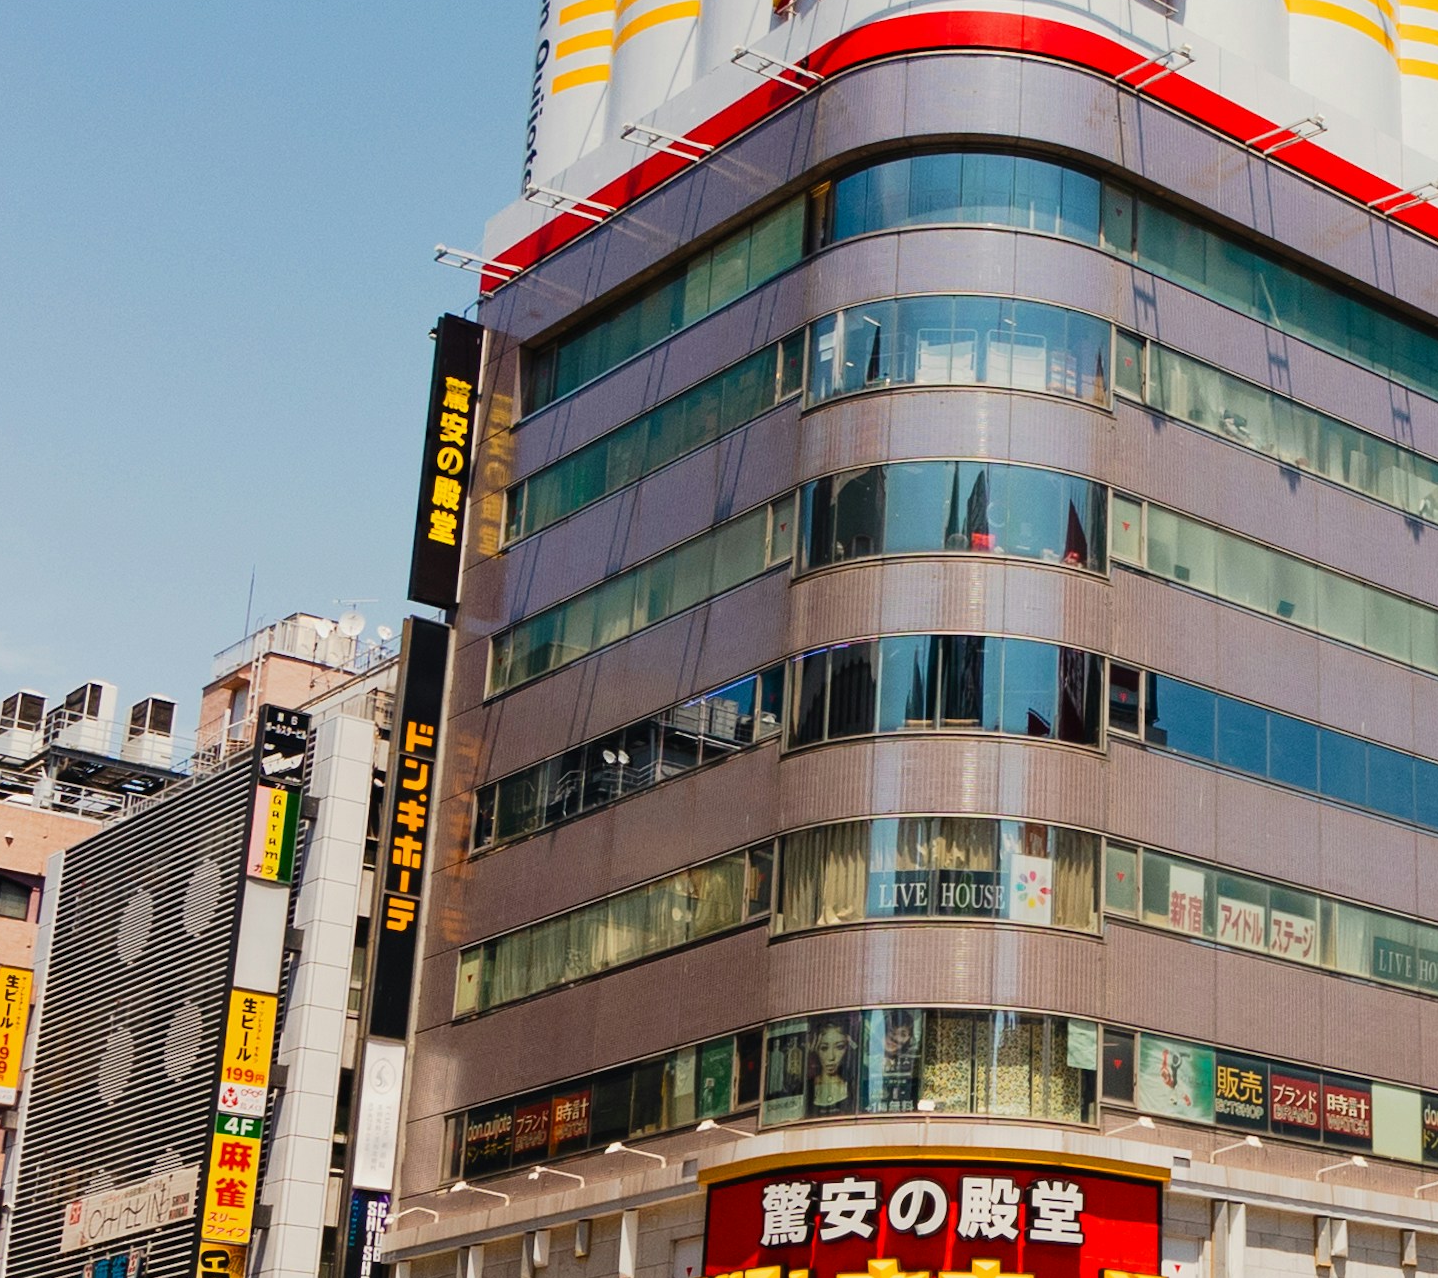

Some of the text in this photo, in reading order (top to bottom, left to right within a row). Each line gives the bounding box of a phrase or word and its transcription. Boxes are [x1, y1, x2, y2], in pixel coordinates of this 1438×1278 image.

[523, 19, 553, 196] Quijote
[428, 376, 474, 547] 驚安の殿堂
[263, 793, 283, 862] Garam
[877, 880, 1006, 910] LIVE HOUSE
[1169, 888, 1317, 959] 新宿 アイドル ステージ
[1378, 947, 1414, 979] LIVE
[0, 973, 21, 1030] 生ビール
[235, 997, 259, 1063] 生ビール
[225, 1065, 265, 1086] 199円
[1216, 1065, 1263, 1106] 販売
[554, 1098, 591, 1124] 時計
[1272, 1082, 1319, 1108] ブランド
[1325, 1092, 1370, 1119] 時計
[223, 1117, 255, 1136] 4F
[514, 1108, 551, 1135] ブランド
[214, 1141, 254, 1209] 麻雀
[207, 1211, 240, 1223] スリー
[759, 1175, 1086, 1250] 驚安の殿堂
